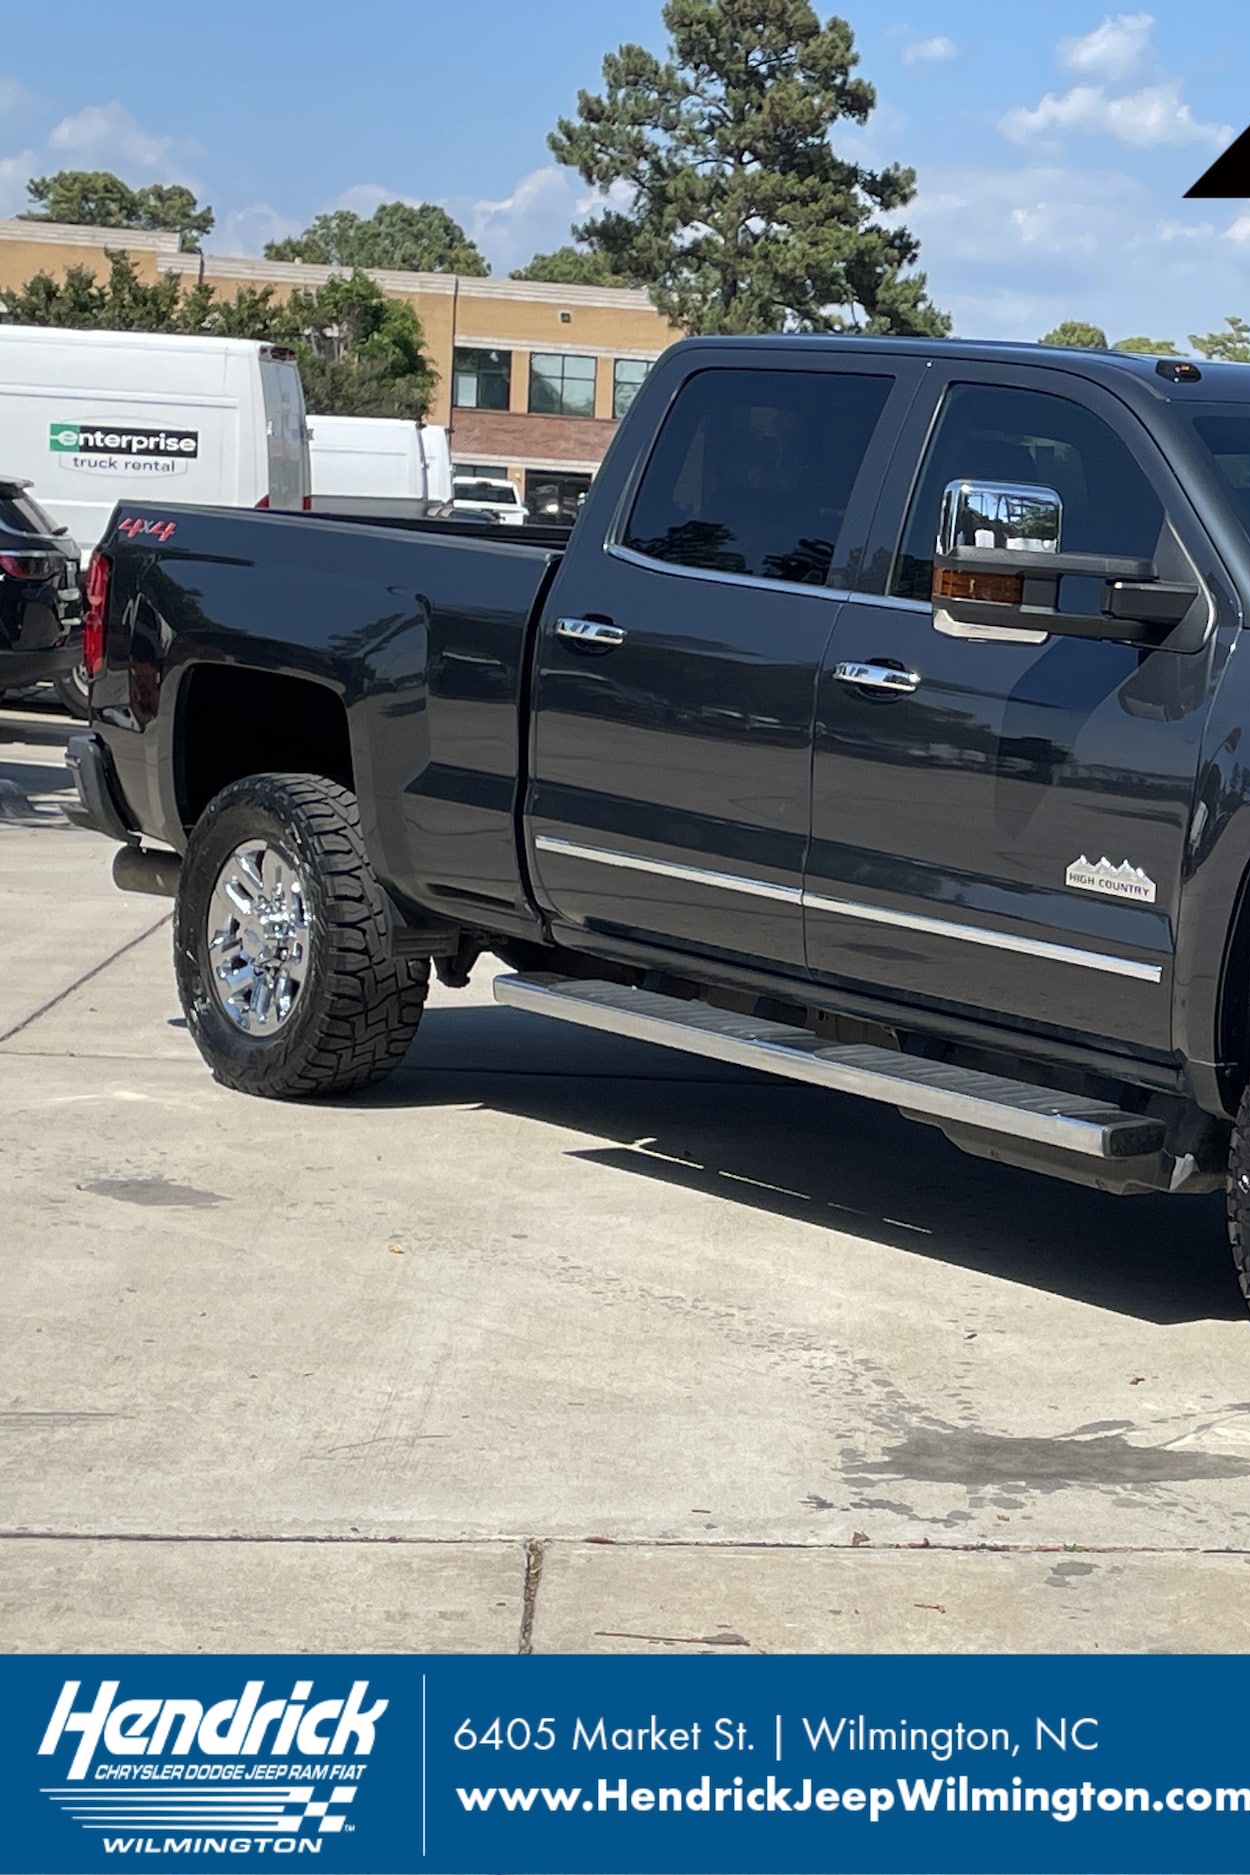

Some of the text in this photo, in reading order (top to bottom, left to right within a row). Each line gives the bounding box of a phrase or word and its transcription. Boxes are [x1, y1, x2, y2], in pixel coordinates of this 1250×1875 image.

[56, 430, 197, 453] enterprise
[73, 457, 176, 473] truck rental
[1069, 872, 1150, 897] HIGH COUNTRY
